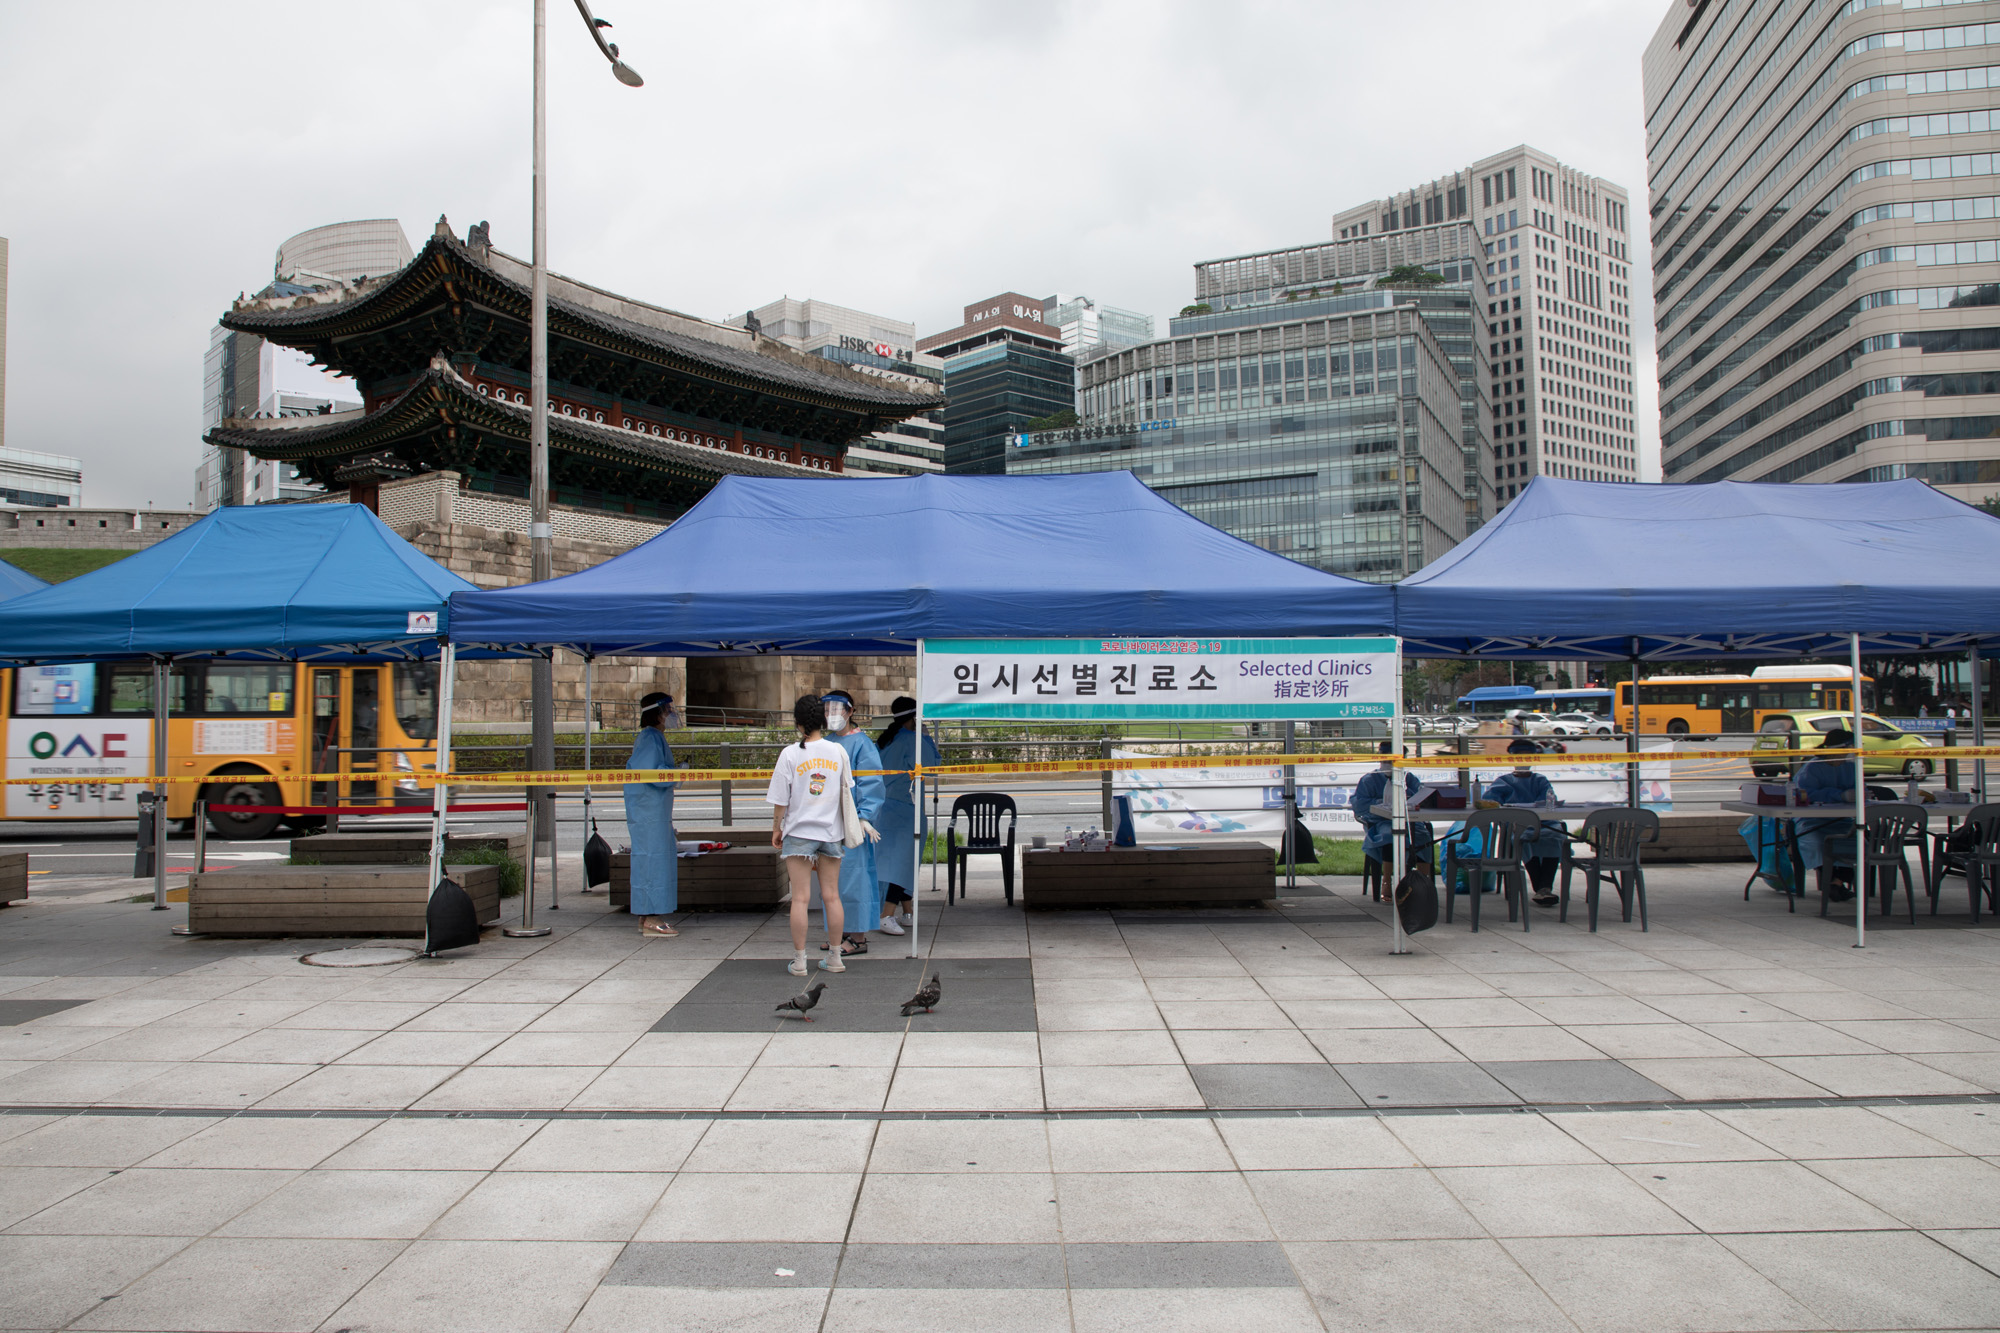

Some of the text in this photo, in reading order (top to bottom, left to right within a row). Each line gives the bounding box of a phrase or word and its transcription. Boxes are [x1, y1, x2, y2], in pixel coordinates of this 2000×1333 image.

[840, 335, 913, 362] HSBC 은행
[1140, 418, 1177, 432] KCCI
[1100, 641, 1199, 653] 코로나바이러스감염증
[1208, 642, 1221, 652] 19
[1239, 659, 1373, 676] Selected Clinics
[953, 663, 1218, 696] 임시선별진료소
[1274, 680, 1349, 699] 指定诊所
[1351, 705, 1386, 716] 중구보건소
[796, 758, 839, 776] STUFFING
[1002, 762, 1059, 772] 위험 출입금지
[1076, 761, 1133, 771] 위험 출입금지
[1150, 759, 1207, 769] 위험 출입금지
[1224, 757, 1280, 767] 위험 출입금지
[76, 766, 126, 775] UNIVERSITY
[586, 772, 641, 782] 위험 출입금지
[658, 772, 713, 781] 위험 출입금지
